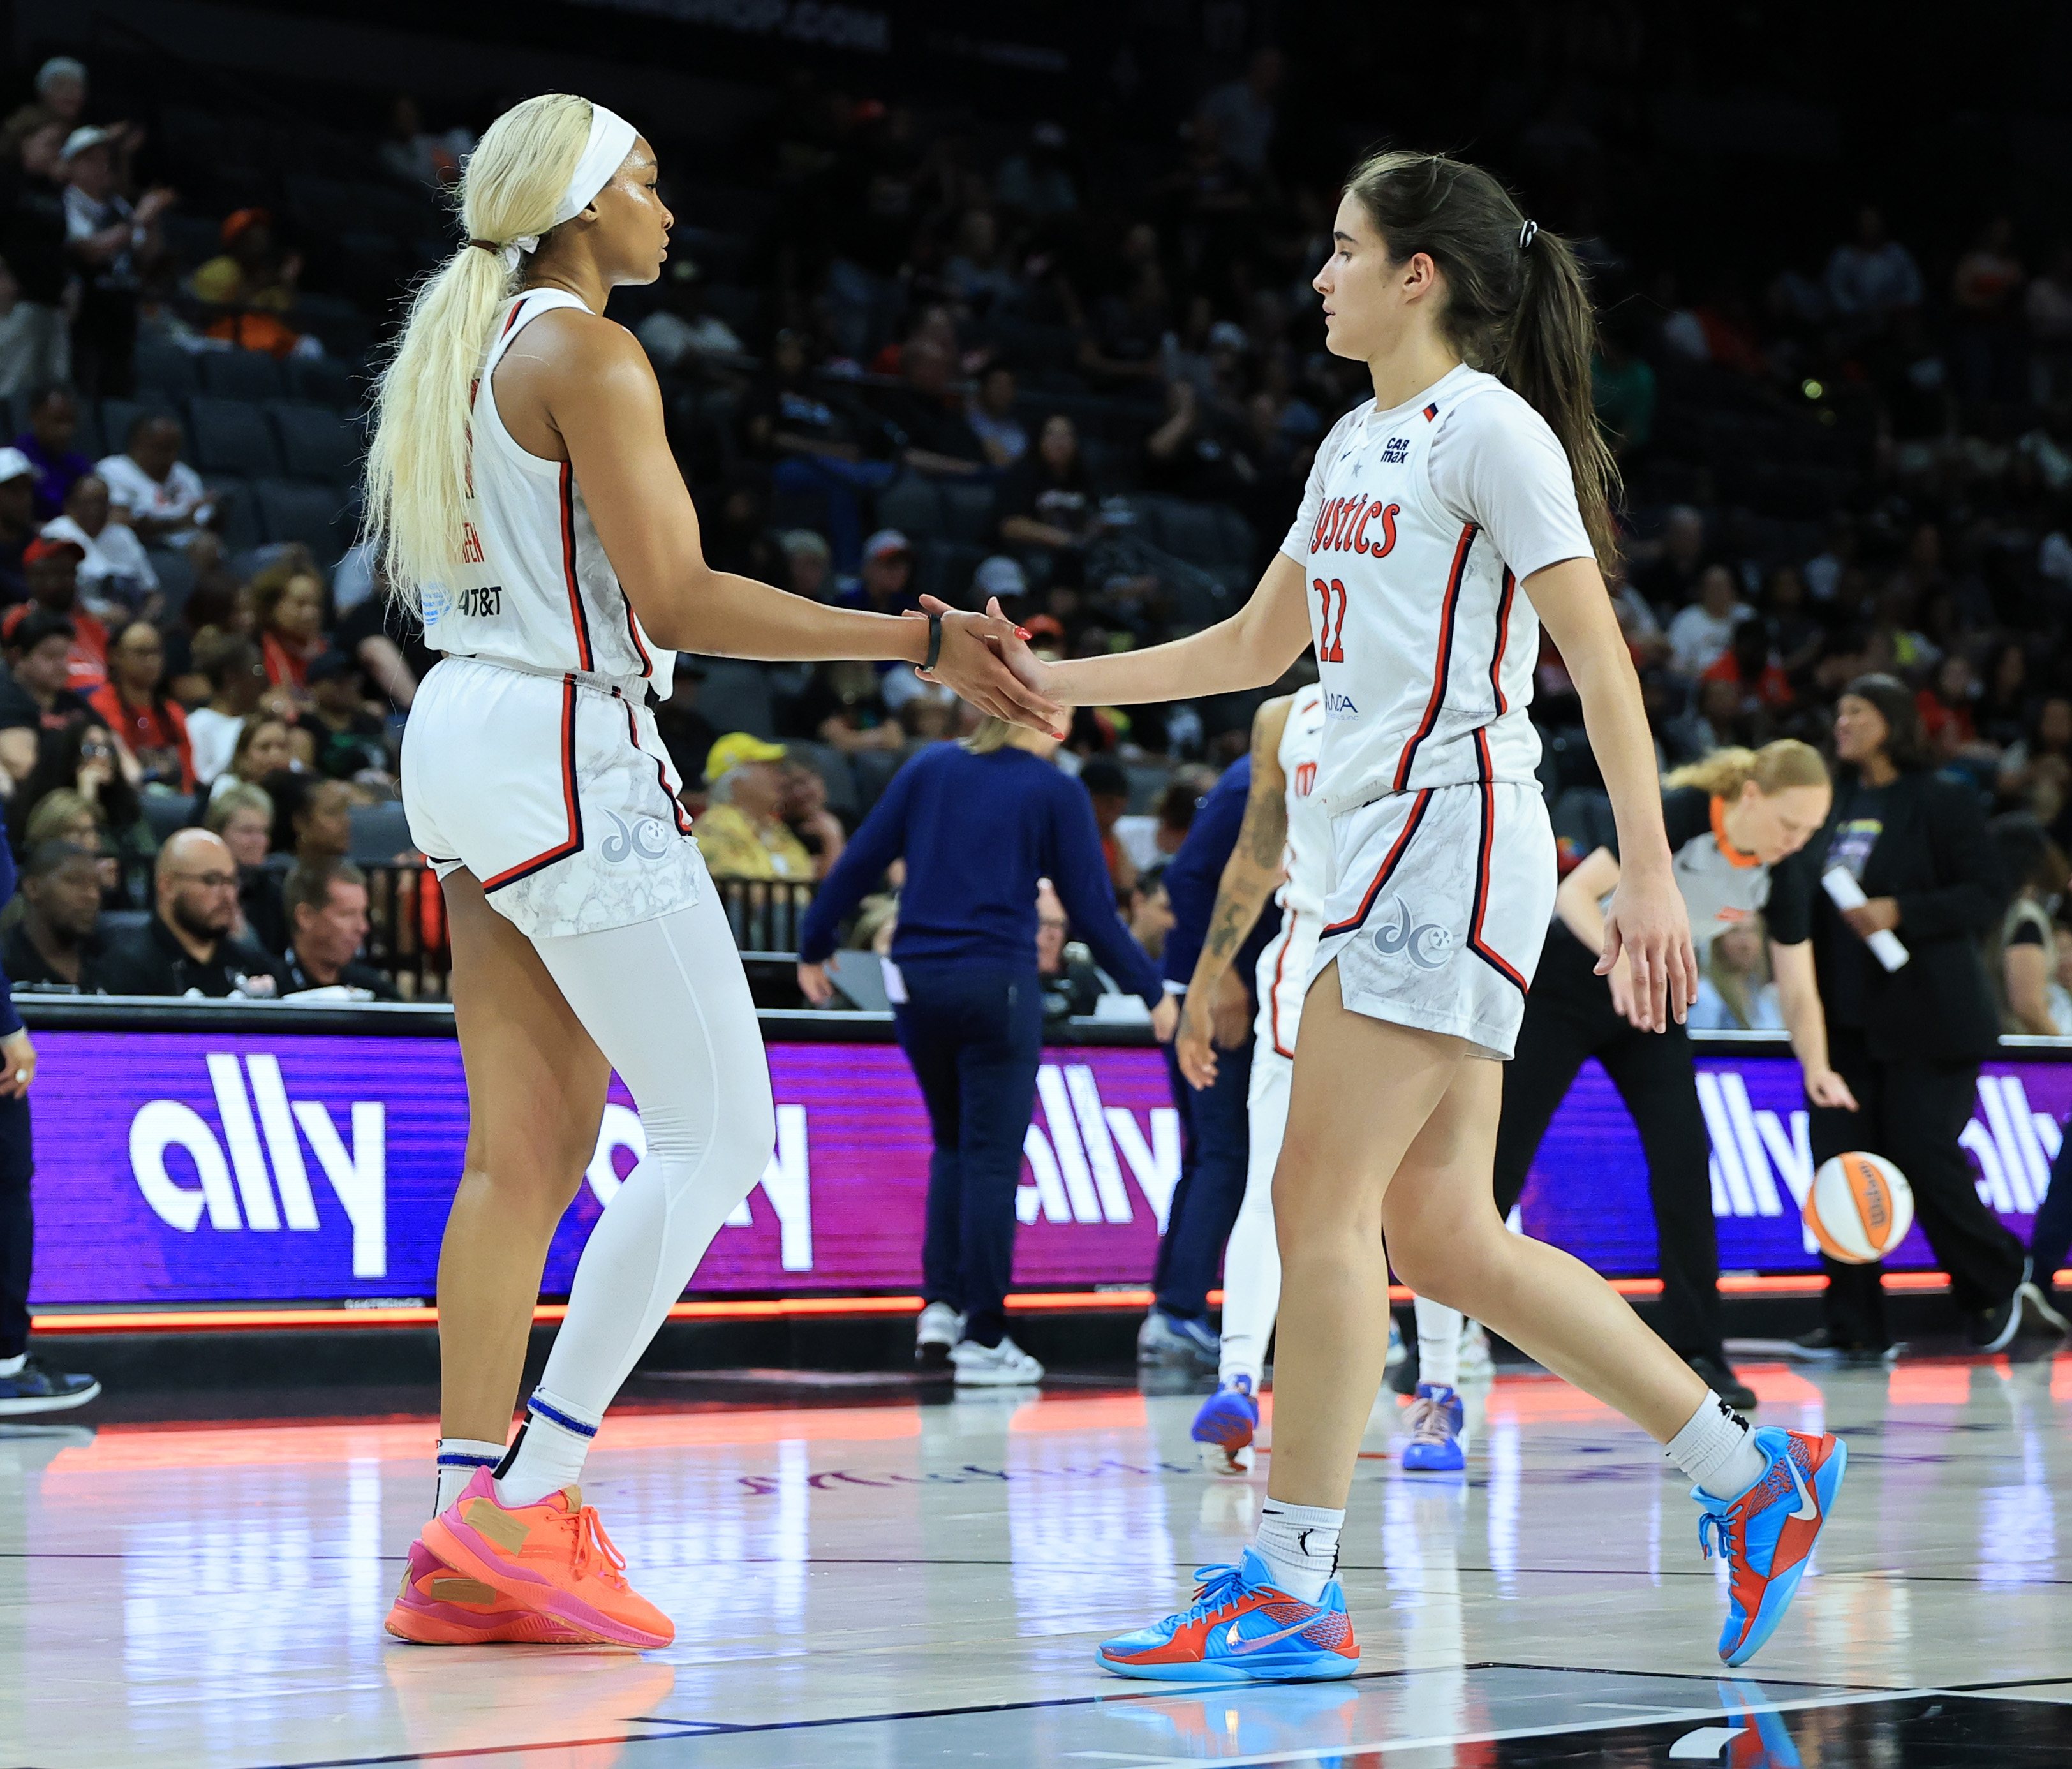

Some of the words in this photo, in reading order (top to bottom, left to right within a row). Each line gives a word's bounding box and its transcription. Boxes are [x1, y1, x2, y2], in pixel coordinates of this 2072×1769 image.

[1387, 438, 1410, 450] CAR
[1308, 493, 1400, 558] ystics
[457, 586, 502, 617] AT&T
[1313, 578, 1347, 663] 22
[129, 1053, 387, 1278] ally
[585, 1103, 814, 1272] ay
[1695, 1072, 1821, 1255] lly
